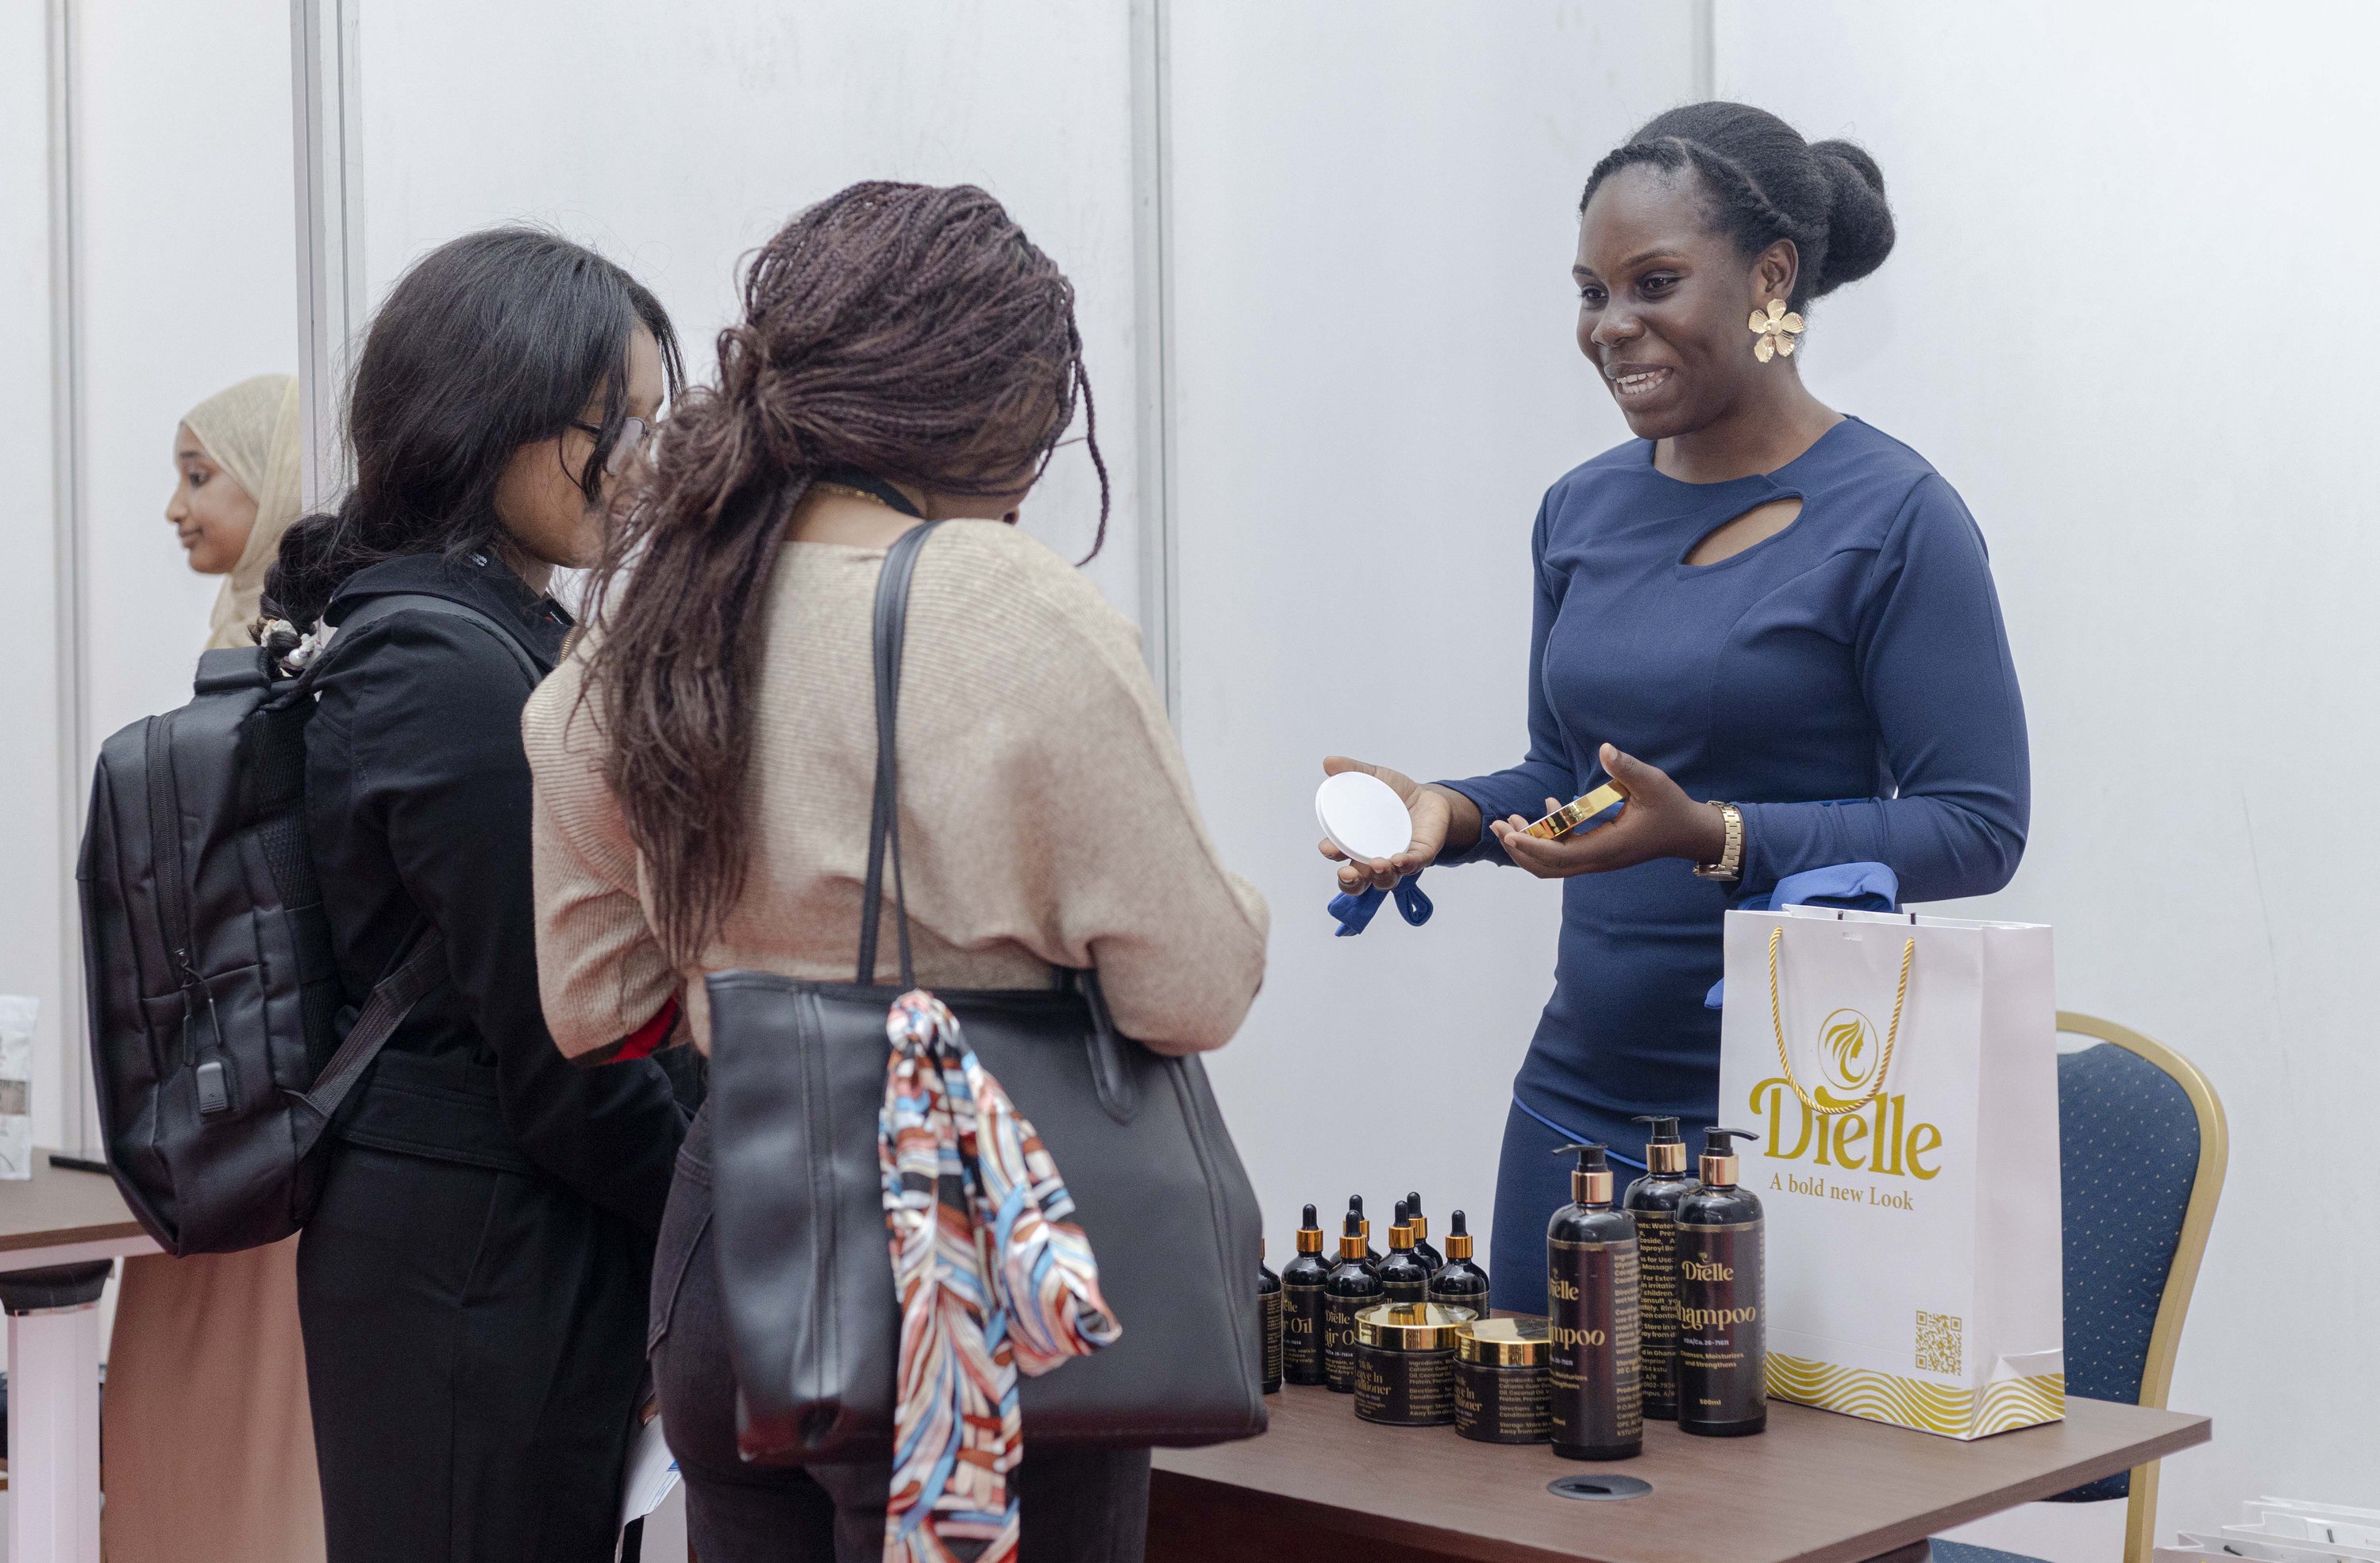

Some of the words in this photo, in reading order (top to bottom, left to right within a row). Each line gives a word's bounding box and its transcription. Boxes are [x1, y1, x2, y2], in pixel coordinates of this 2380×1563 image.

[1749, 1077, 1943, 1180] Dielle
[1769, 1172, 1783, 1191] A
[1789, 1173, 1824, 1197] bold
[1830, 1186, 1864, 1203] new
[1869, 1186, 1915, 1211] Look
[1681, 1261, 1735, 1281] Dielle
[1291, 1318, 1313, 1334] Oil
[1325, 1308, 1350, 1325] Dielle
[1550, 1326, 1605, 1351] mpoo
